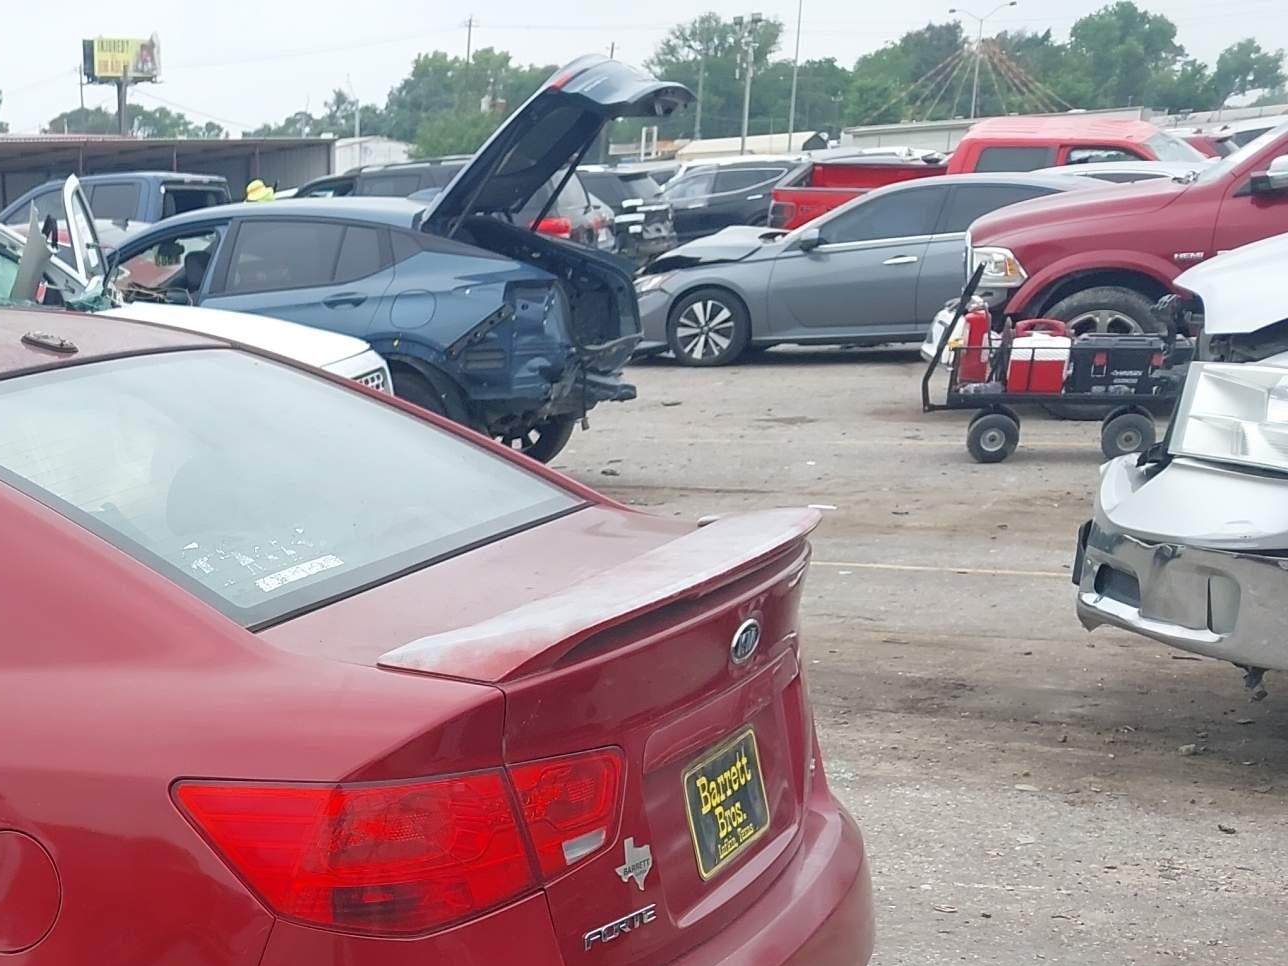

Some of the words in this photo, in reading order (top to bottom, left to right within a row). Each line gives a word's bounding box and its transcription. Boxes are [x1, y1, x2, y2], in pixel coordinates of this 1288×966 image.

[696, 745, 752, 816] Barrett
[714, 801, 747, 839] Bros.
[584, 903, 657, 951] FORTE
